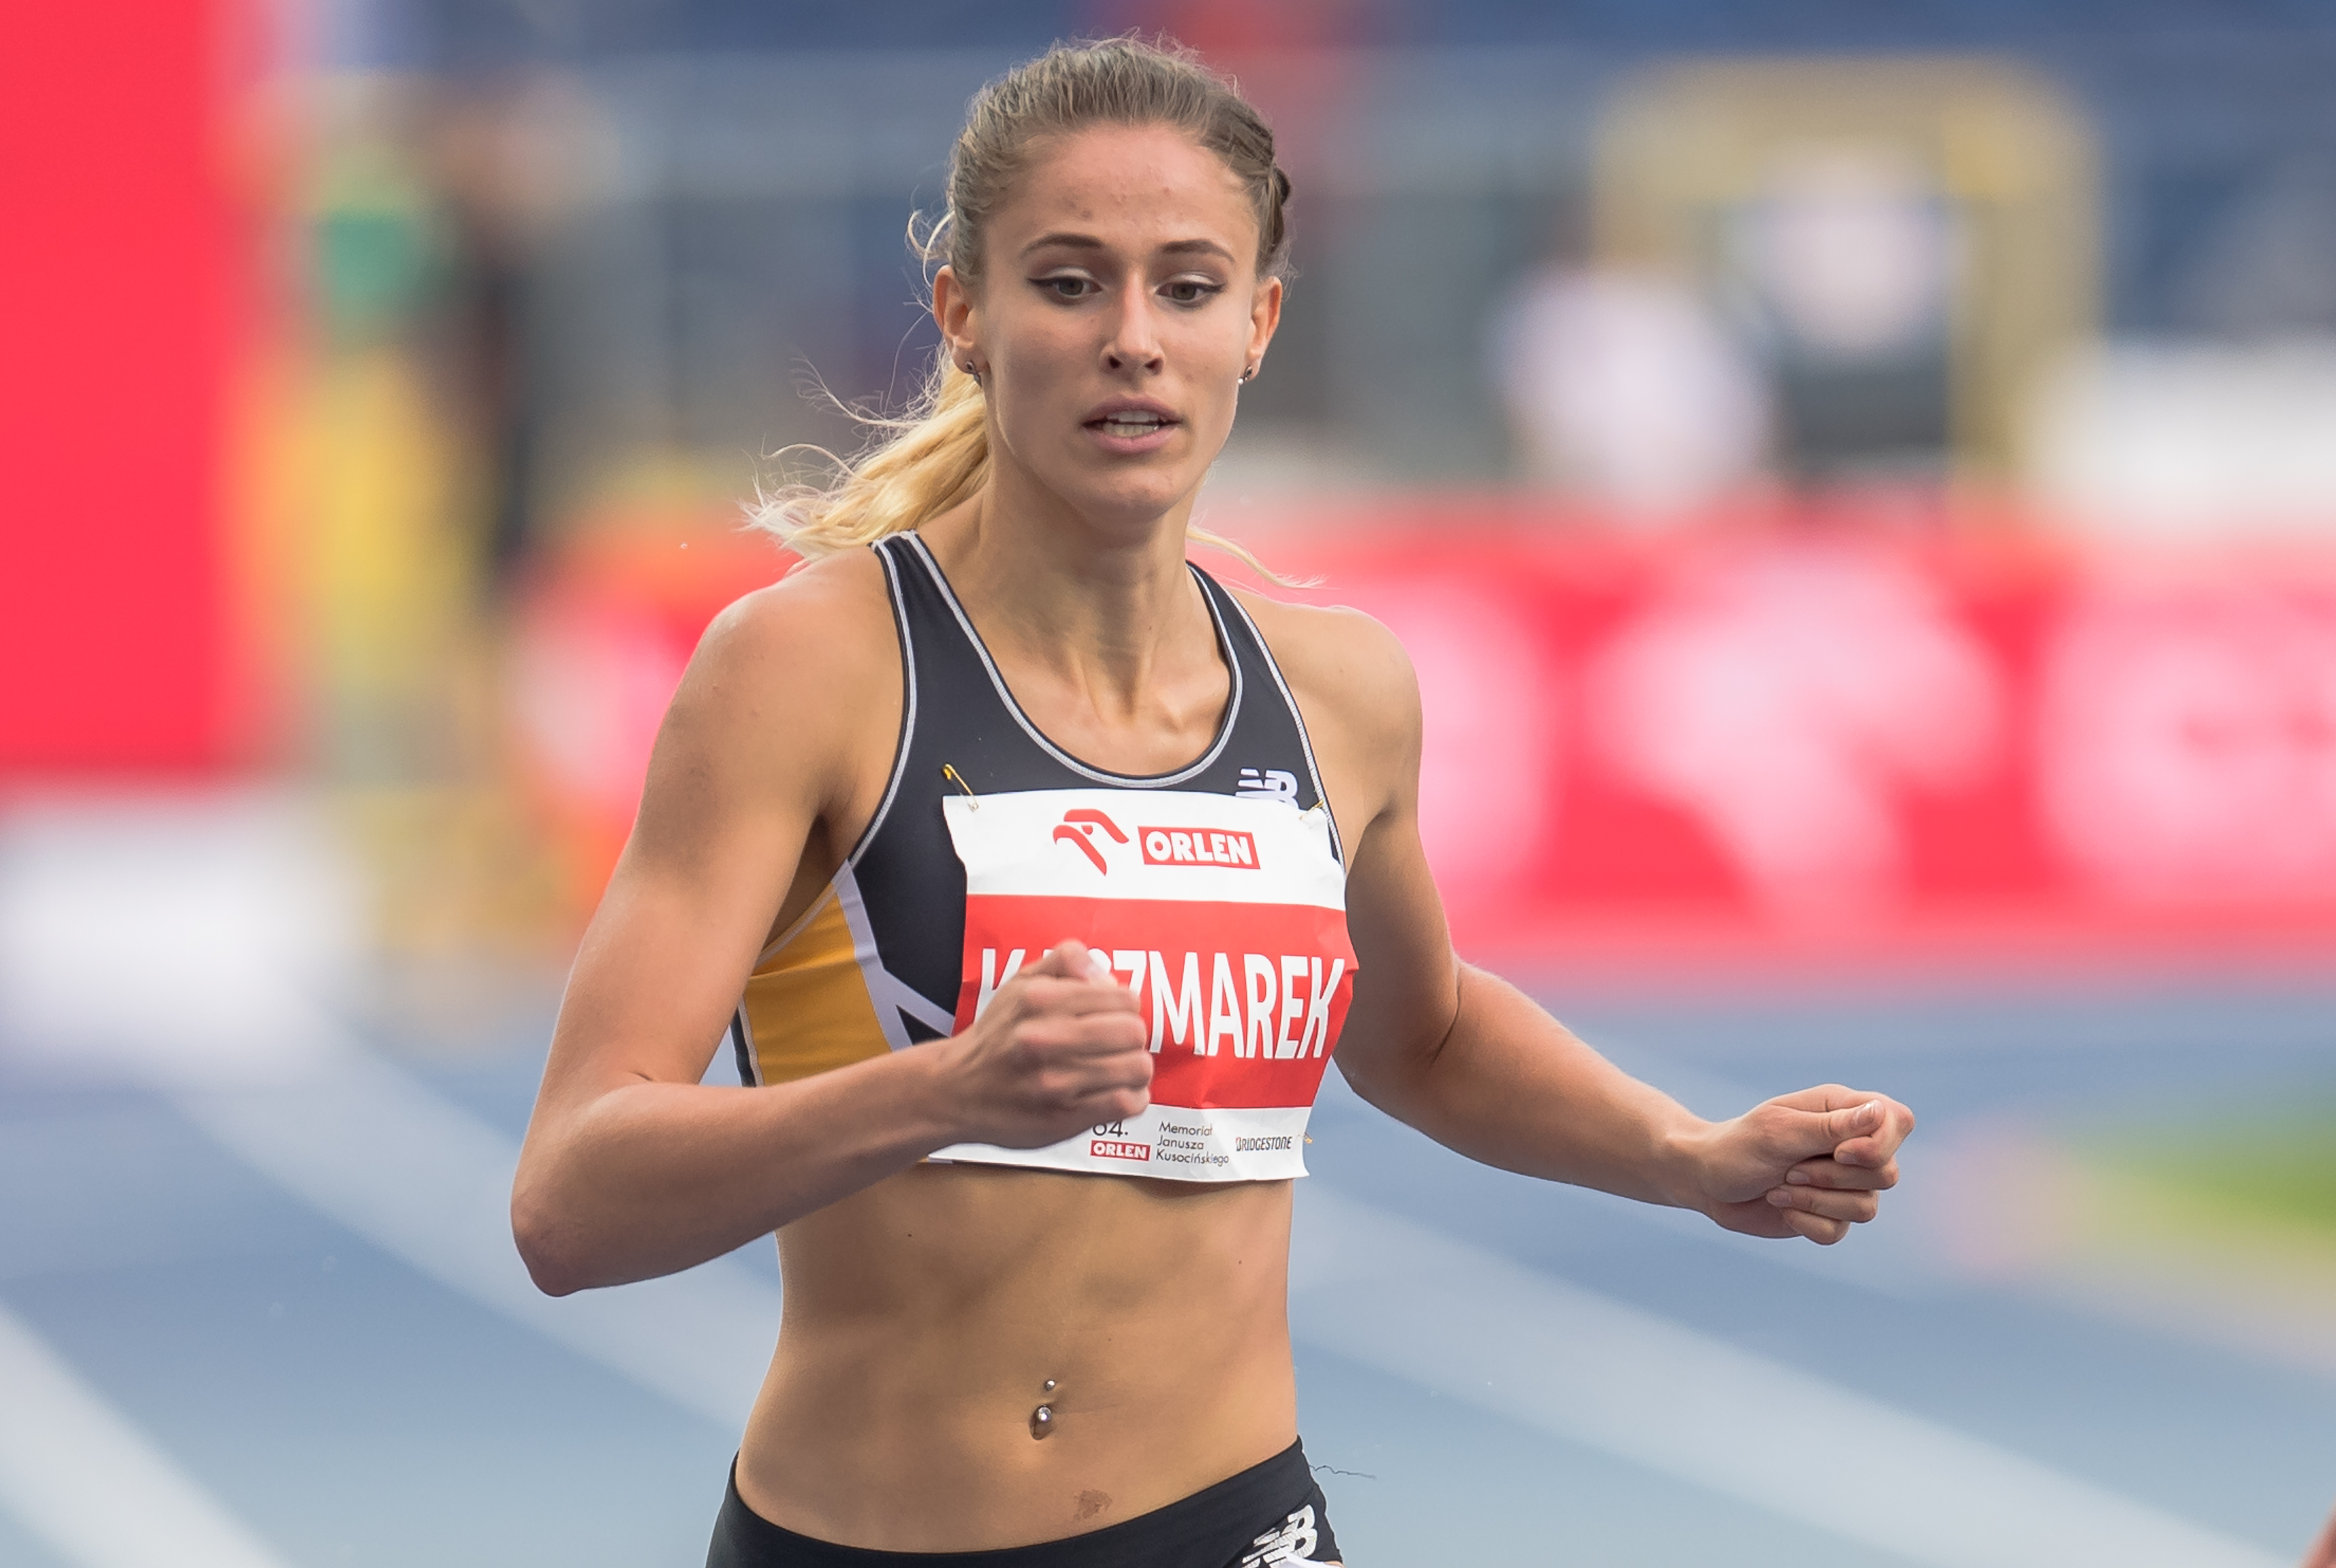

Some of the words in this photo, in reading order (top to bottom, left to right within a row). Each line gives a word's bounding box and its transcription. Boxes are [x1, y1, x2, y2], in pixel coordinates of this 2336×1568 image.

[1146, 832, 1253, 865] ORLEN
[973, 947, 1345, 1058] KMAREK
[1092, 1142, 1148, 1159] ORLEN
[1156, 1135, 1205, 1150] Janusza
[1236, 1136, 1293, 1152] BRIDGESTONE
[1156, 1148, 1230, 1167] Kusocińskiego
